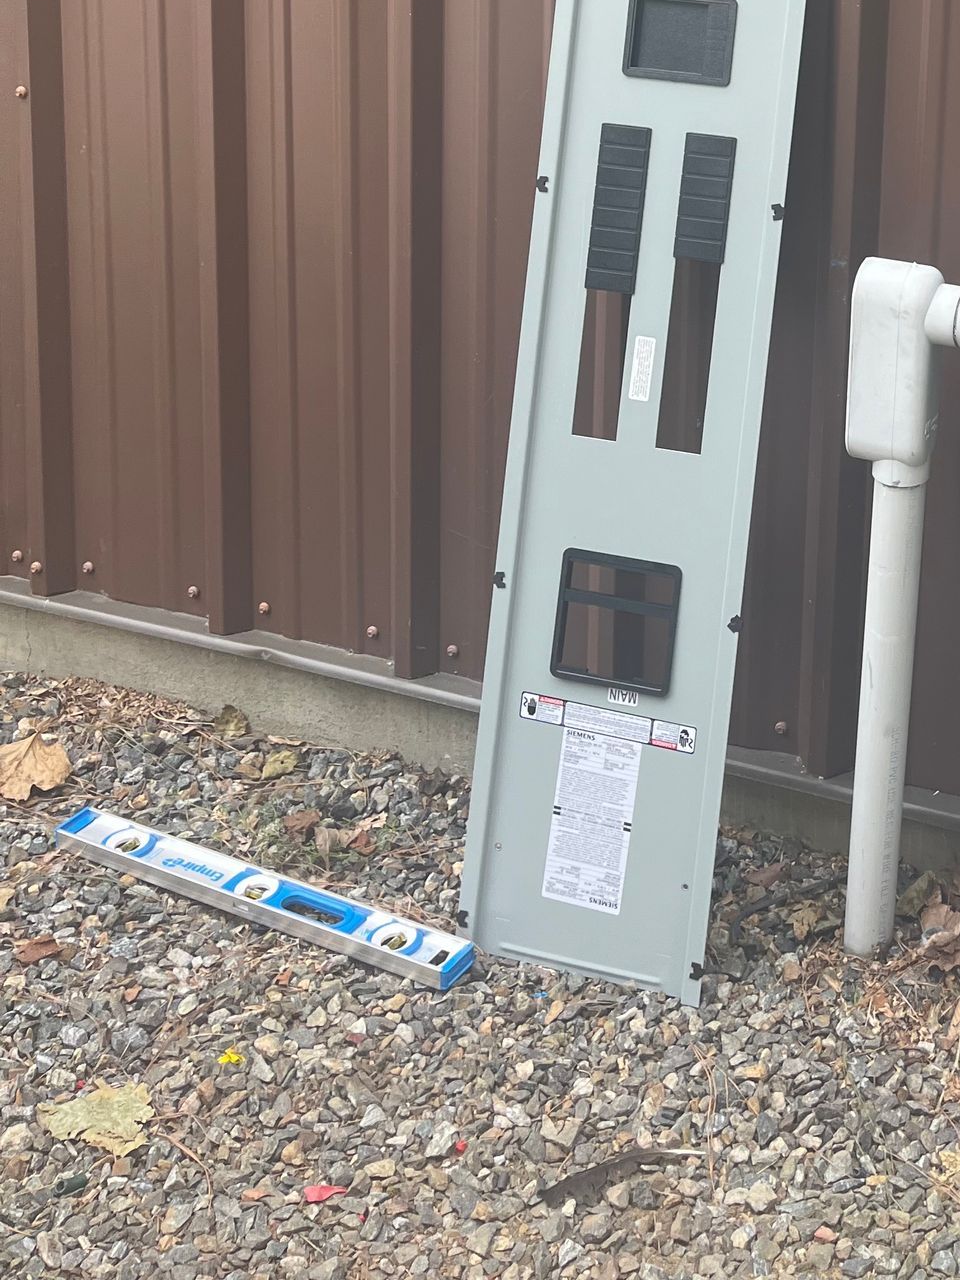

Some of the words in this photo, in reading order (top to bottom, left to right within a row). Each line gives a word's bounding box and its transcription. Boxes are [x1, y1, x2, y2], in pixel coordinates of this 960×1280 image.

[609, 689, 637, 704] MAIN
[566, 729, 596, 741] SIEMENS
[172, 858, 224, 882] Empire
[589, 897, 618, 909] SIEMENS
